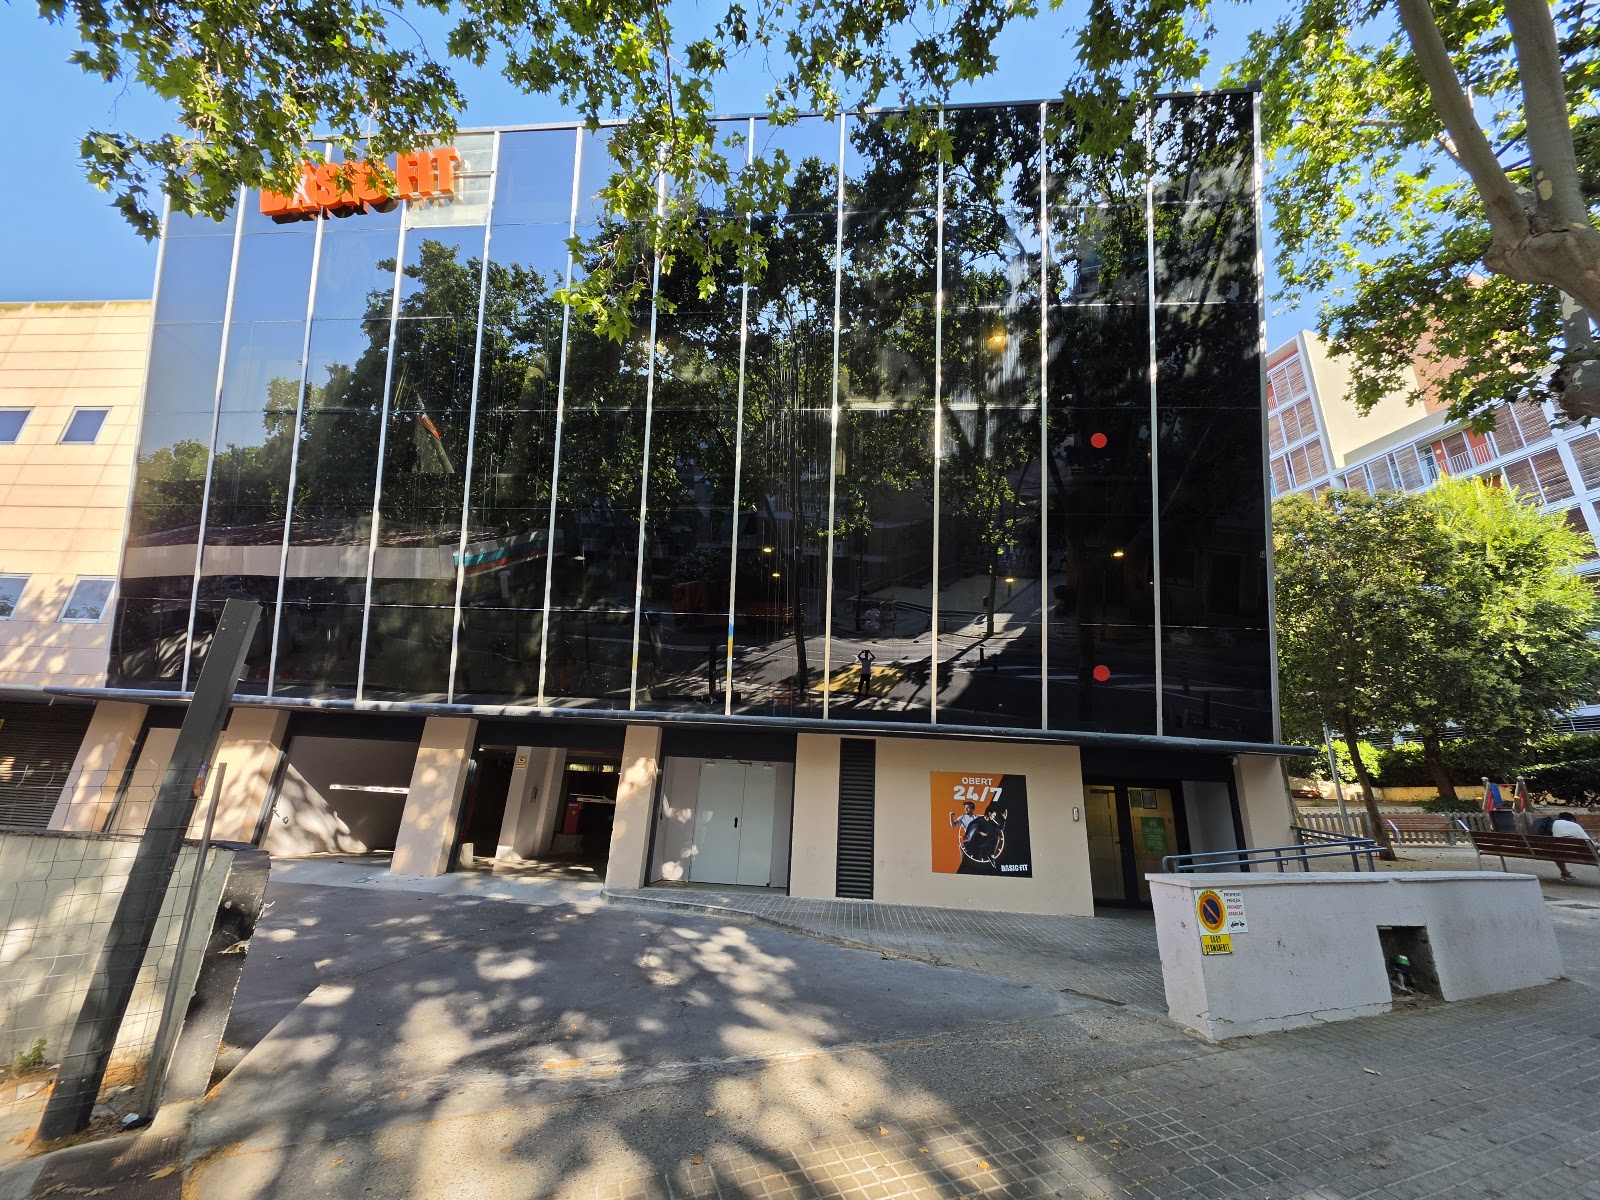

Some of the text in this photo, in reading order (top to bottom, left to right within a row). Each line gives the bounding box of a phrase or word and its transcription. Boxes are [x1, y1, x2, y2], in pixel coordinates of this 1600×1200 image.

[961, 777, 993, 785] OBERT
[953, 785, 1003, 802] 24/7
[1000, 864, 1028, 872] BASIC-FIT
